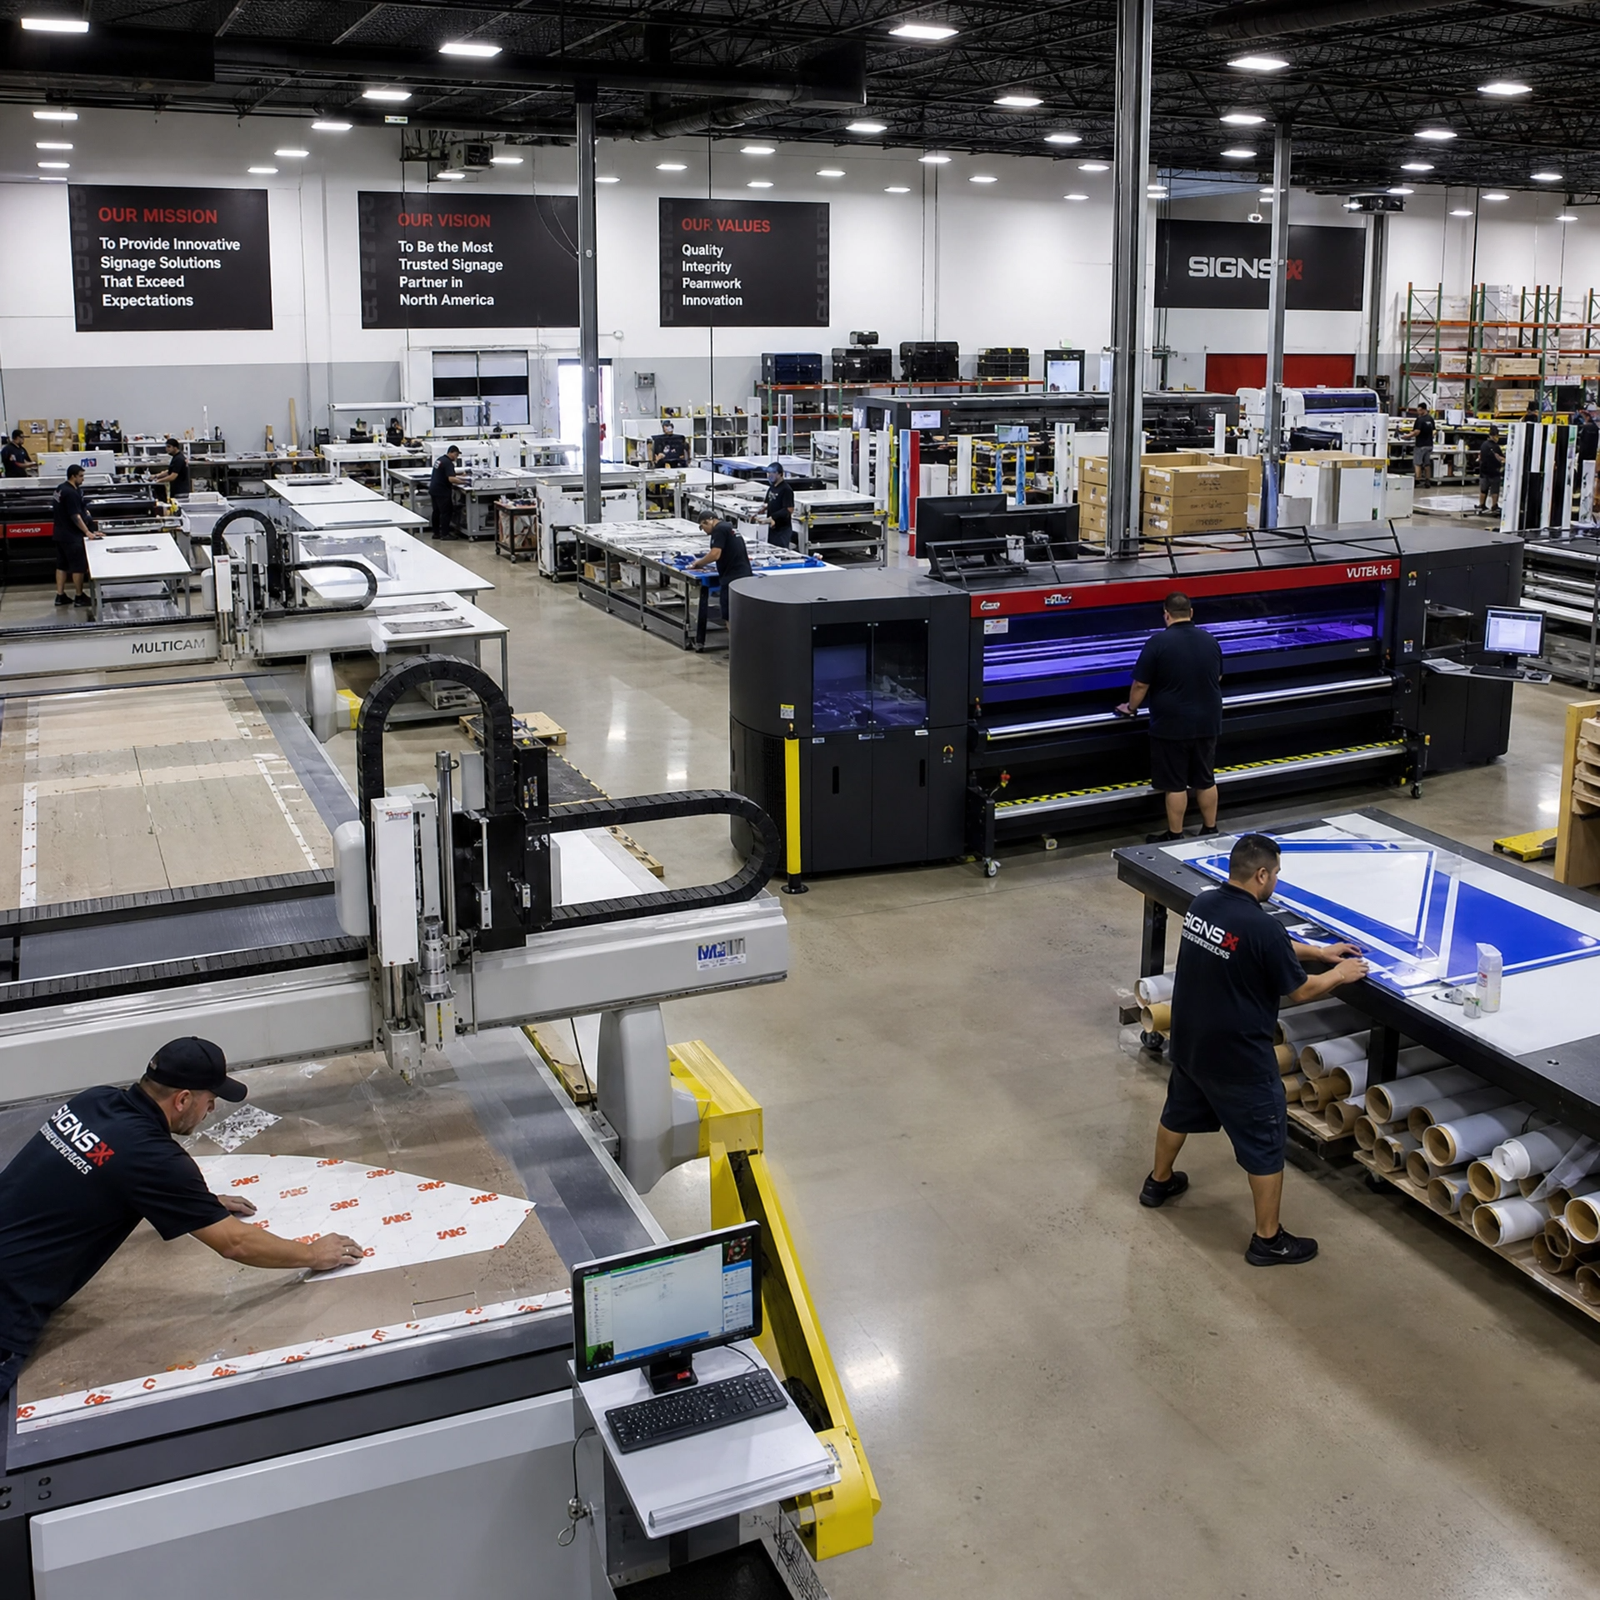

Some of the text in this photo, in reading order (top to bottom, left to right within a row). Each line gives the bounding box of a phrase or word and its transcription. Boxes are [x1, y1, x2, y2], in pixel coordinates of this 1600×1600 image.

[98, 206, 218, 224] OUR MISSION
[397, 213, 491, 227] OUR VISION
[681, 217, 771, 233] OUR VALUES
[98, 236, 241, 251] To Provide Innovative
[397, 240, 494, 253] To Be the Most
[681, 243, 724, 259] Quality
[100, 255, 222, 272] Signage Solutions
[398, 258, 504, 274] Trusted Signage
[682, 260, 732, 275] Integrity
[100, 274, 185, 288] That Exceed
[399, 275, 463, 289] Partner in
[102, 293, 194, 310] Expectations
[399, 293, 495, 306] North America
[682, 294, 743, 306] Innovation
[131, 638, 206, 654] MULTICAM
